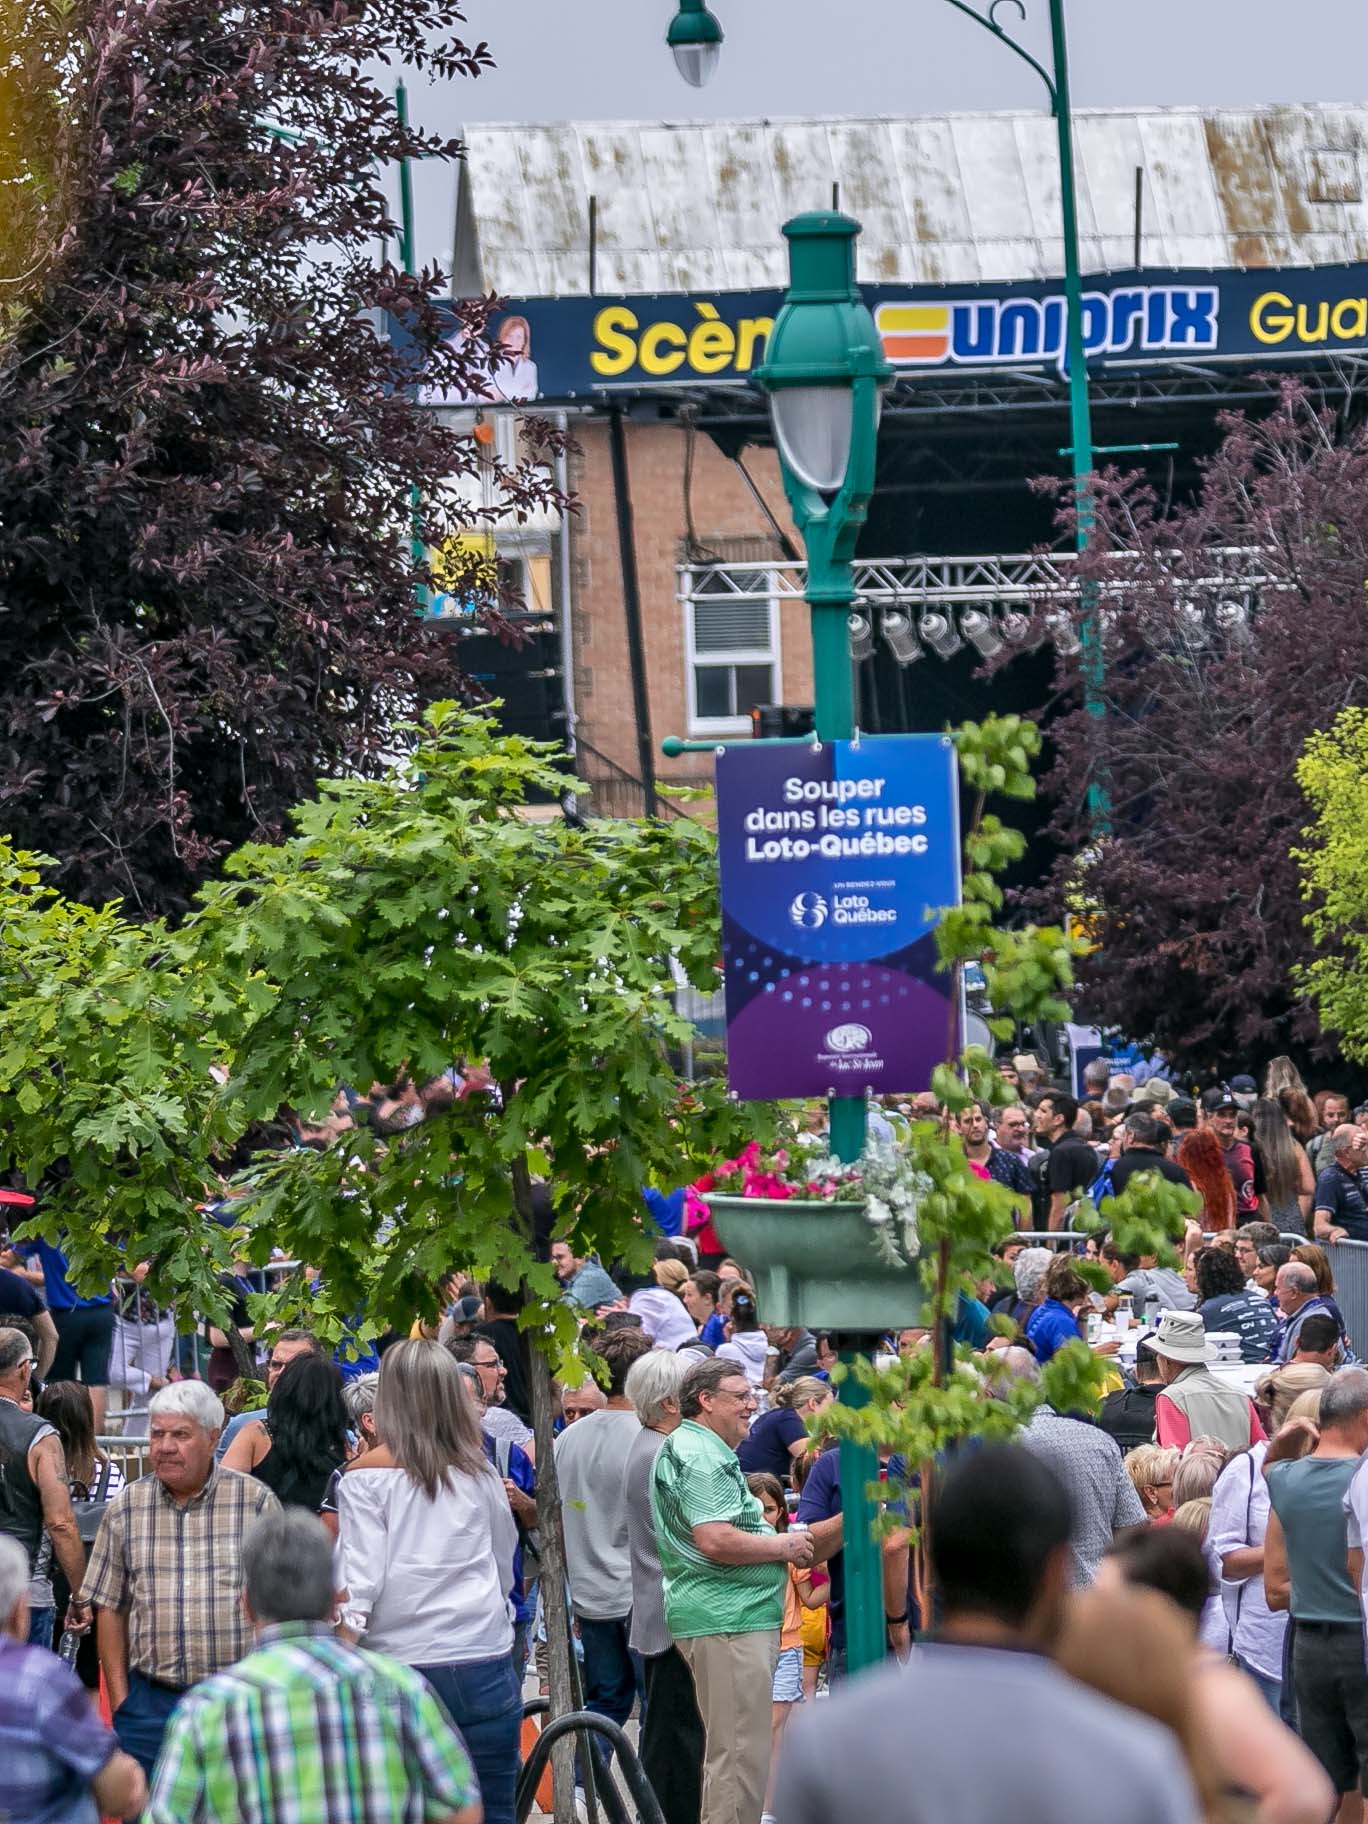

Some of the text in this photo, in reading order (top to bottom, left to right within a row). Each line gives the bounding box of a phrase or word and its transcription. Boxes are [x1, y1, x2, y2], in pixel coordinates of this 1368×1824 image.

[590, 302, 776, 376] Scèn
[951, 287, 1219, 380] uniprix
[785, 777, 885, 803] Souper
[745, 805, 927, 832] dans les rues
[747, 831, 929, 861] Loto-Québec
[833, 895, 870, 909] Loto
[833, 907, 897, 923] Québec
